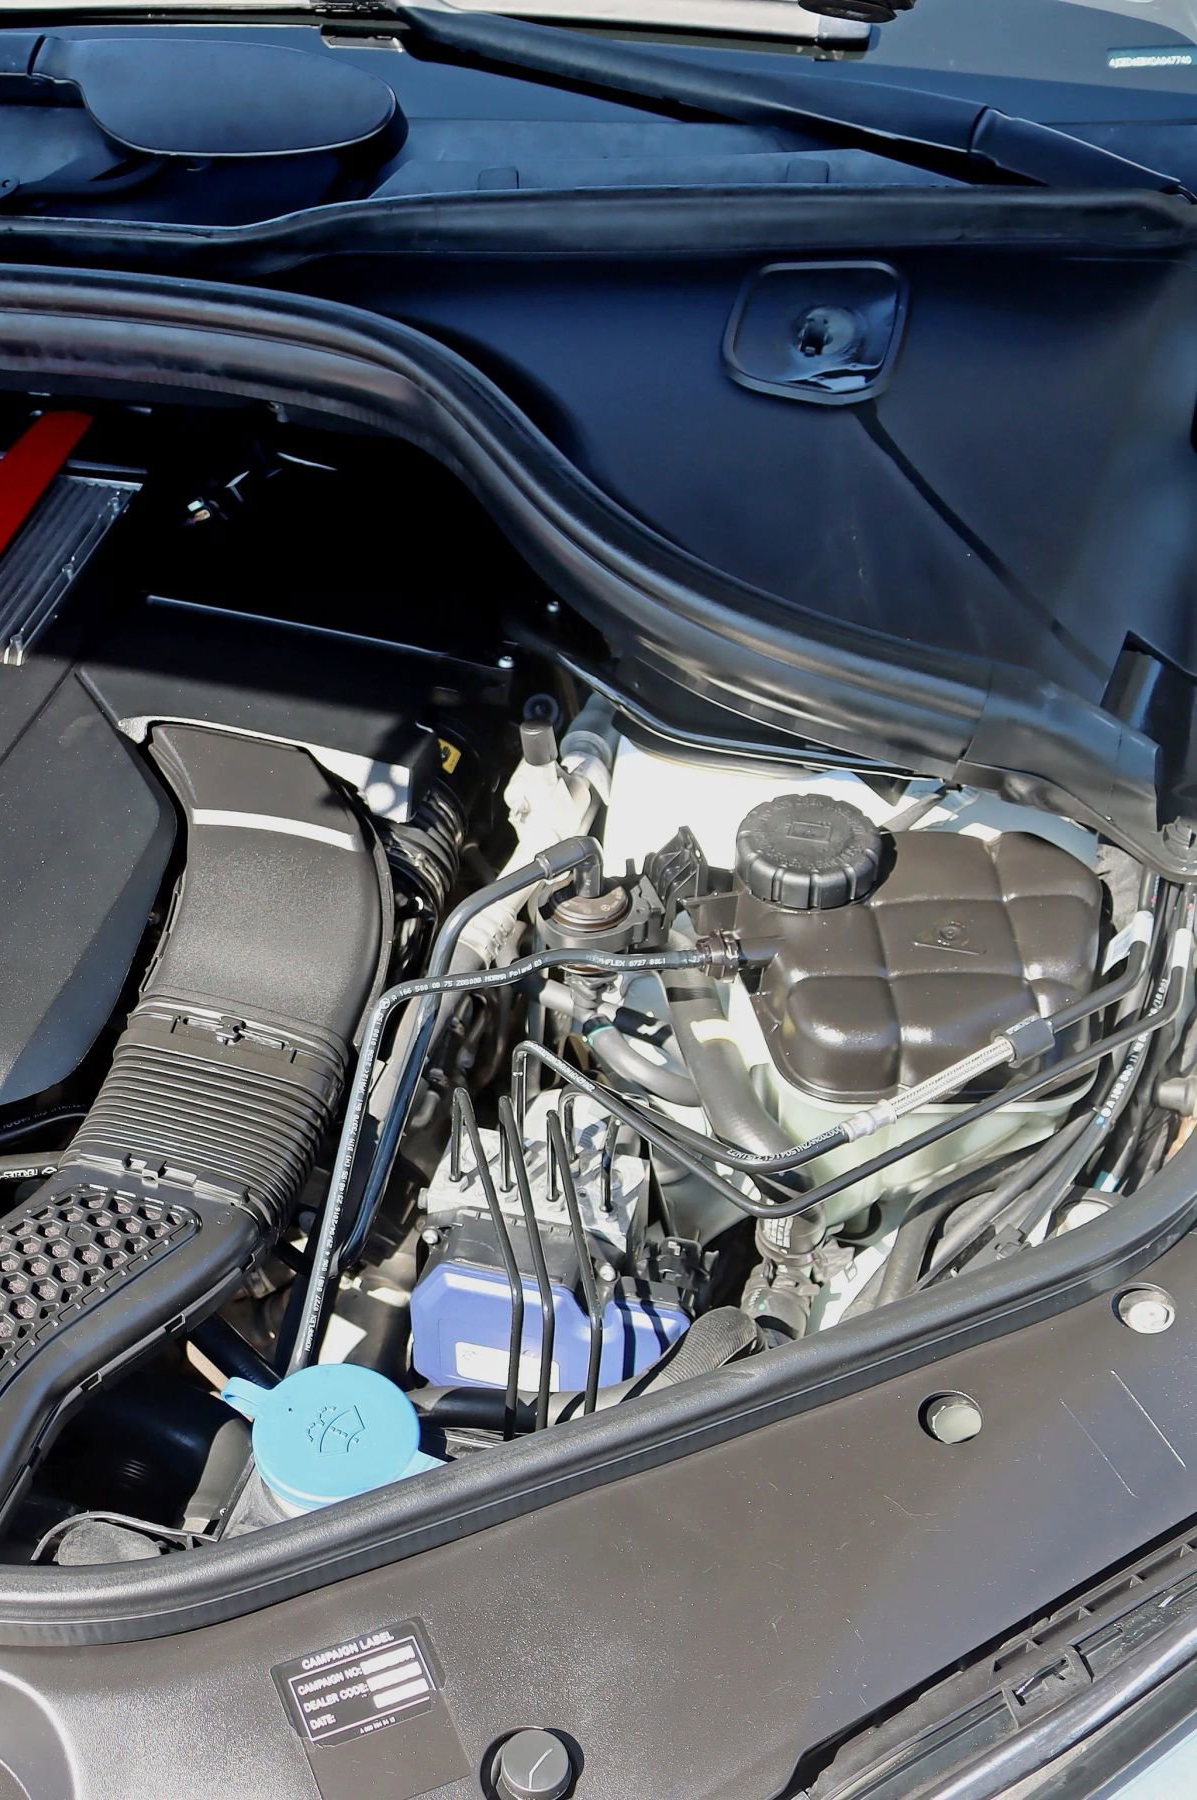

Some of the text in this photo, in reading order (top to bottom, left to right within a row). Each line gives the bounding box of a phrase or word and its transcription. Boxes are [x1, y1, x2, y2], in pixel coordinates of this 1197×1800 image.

[444, 980, 453, 988] 75
[484, 973, 507, 983] NORMA
[509, 963, 533, 979] Poland
[305, 1314, 316, 1352] NORMAFLEX
[348, 1138, 356, 1151] DIN
[302, 1630, 395, 1671] CAMPAIGN LABEL
[297, 1666, 363, 1696] CAMPAIGN NO:
[303, 1682, 369, 1714] DEALER CODE:
[309, 1713, 337, 1731] DATE:
